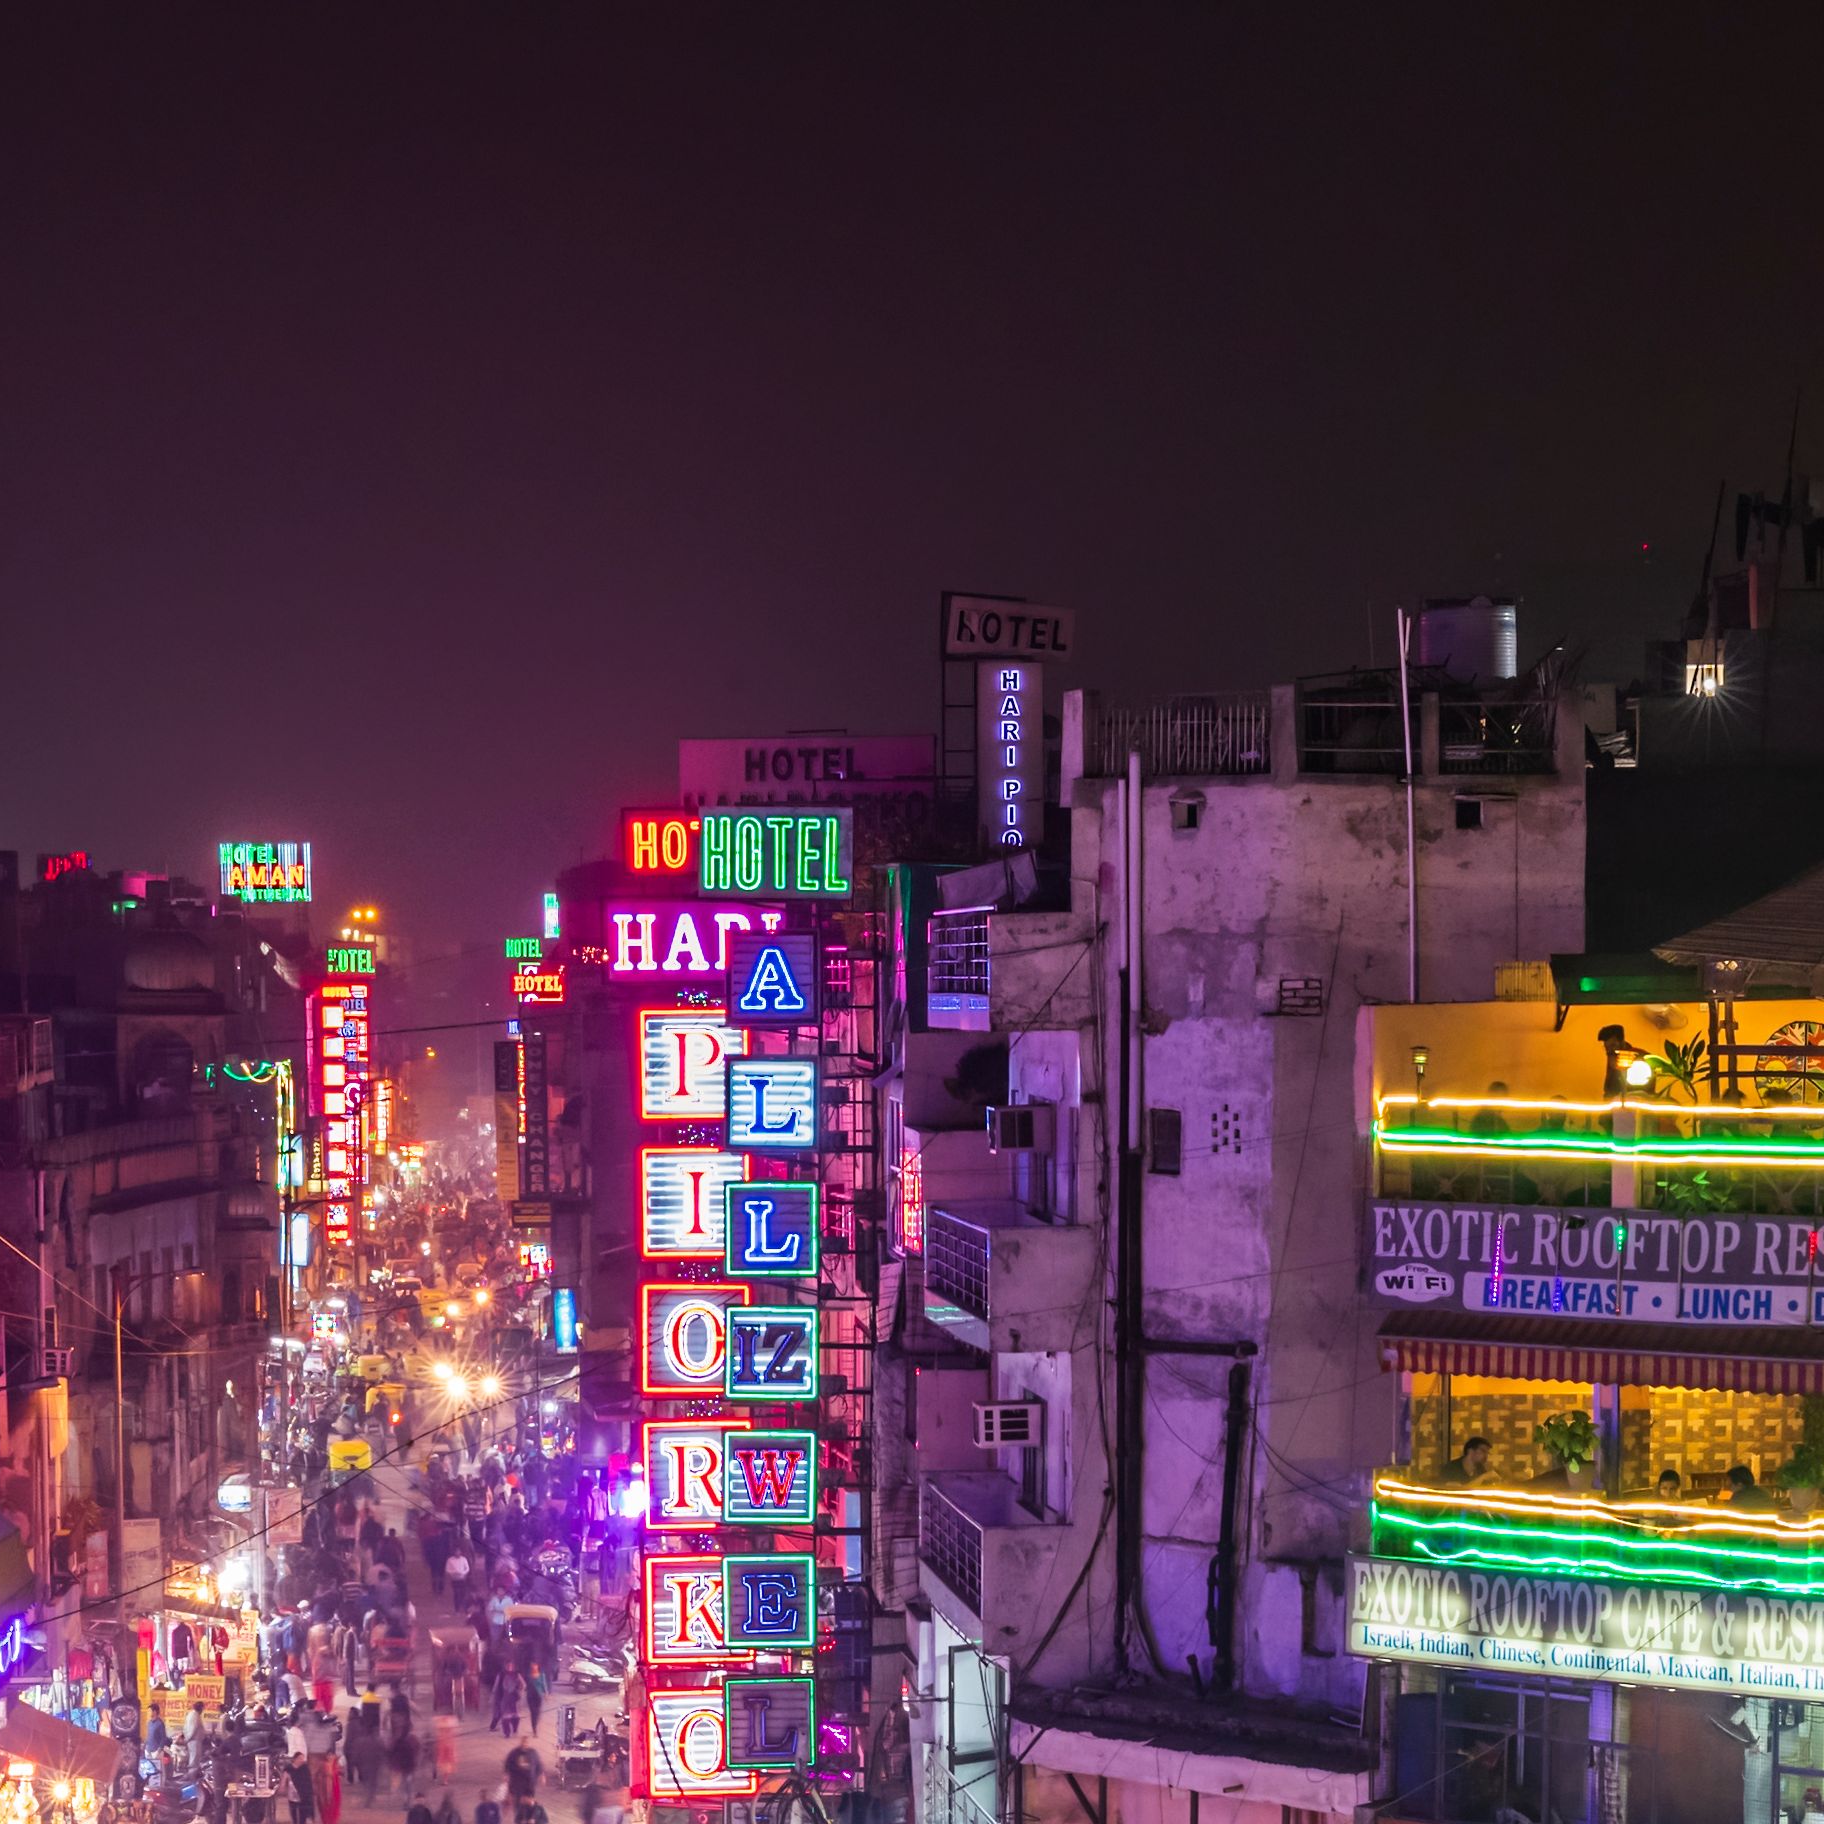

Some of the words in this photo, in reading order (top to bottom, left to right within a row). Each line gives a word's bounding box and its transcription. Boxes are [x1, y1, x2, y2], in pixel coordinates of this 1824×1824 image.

[999, 670, 1020, 766] HARI
[220, 846, 277, 864] HOTEL
[703, 817, 847, 890] HOTEL
[229, 865, 304, 885] AMAN
[328, 950, 375, 973] HOTEL
[506, 939, 541, 958] HOTEL
[514, 976, 562, 991] HOTEL
[1374, 1208, 1527, 1266] EXOTIC
[1531, 1215, 1741, 1275] ROOFTOP
[1485, 1274, 1637, 1315] BREAKFAST
[1680, 1287, 1789, 1320] LUNCH
[1353, 1562, 1459, 1627] EXOTIC
[1469, 1572, 1613, 1646] ROOFTOP
[1622, 1588, 1703, 1653] CAFE
[1711, 1602, 1734, 1661] &
[1421, 1631, 1474, 1658] Indian,
[1480, 1639, 1545, 1668] Chinese,
[1552, 1646, 1651, 1676] Continental,
[1658, 1657, 1733, 1684] Maxican,
[187, 1684, 222, 1698] MONEY
